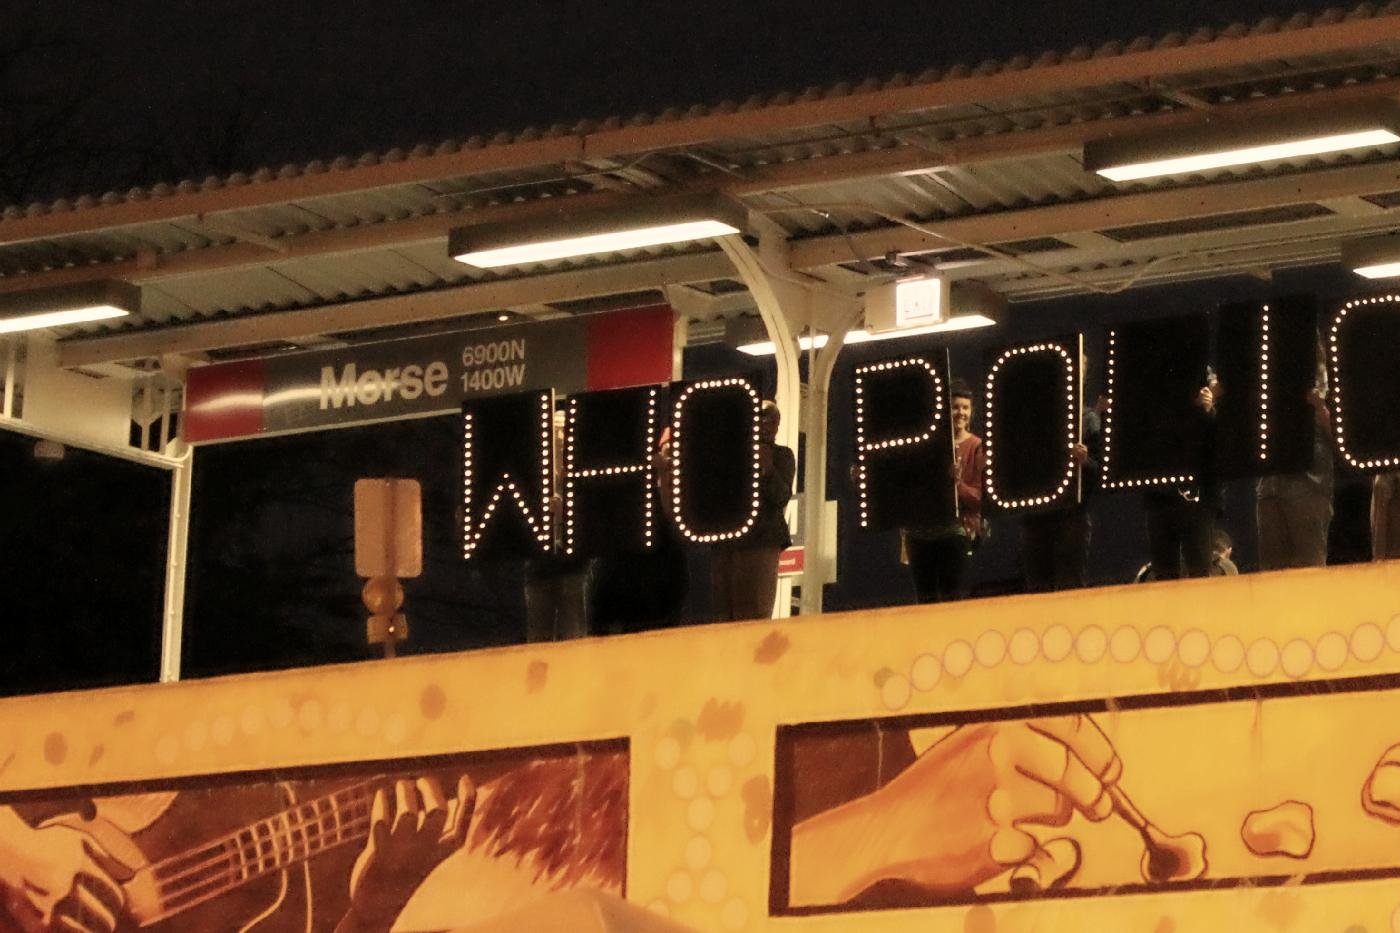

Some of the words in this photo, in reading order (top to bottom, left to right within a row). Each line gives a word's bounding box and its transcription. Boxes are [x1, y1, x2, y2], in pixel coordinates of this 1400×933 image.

[461, 338, 526, 365] 6900N
[318, 361, 449, 411] Morse
[460, 363, 526, 392] 1400W
[462, 378, 761, 561] WHO
